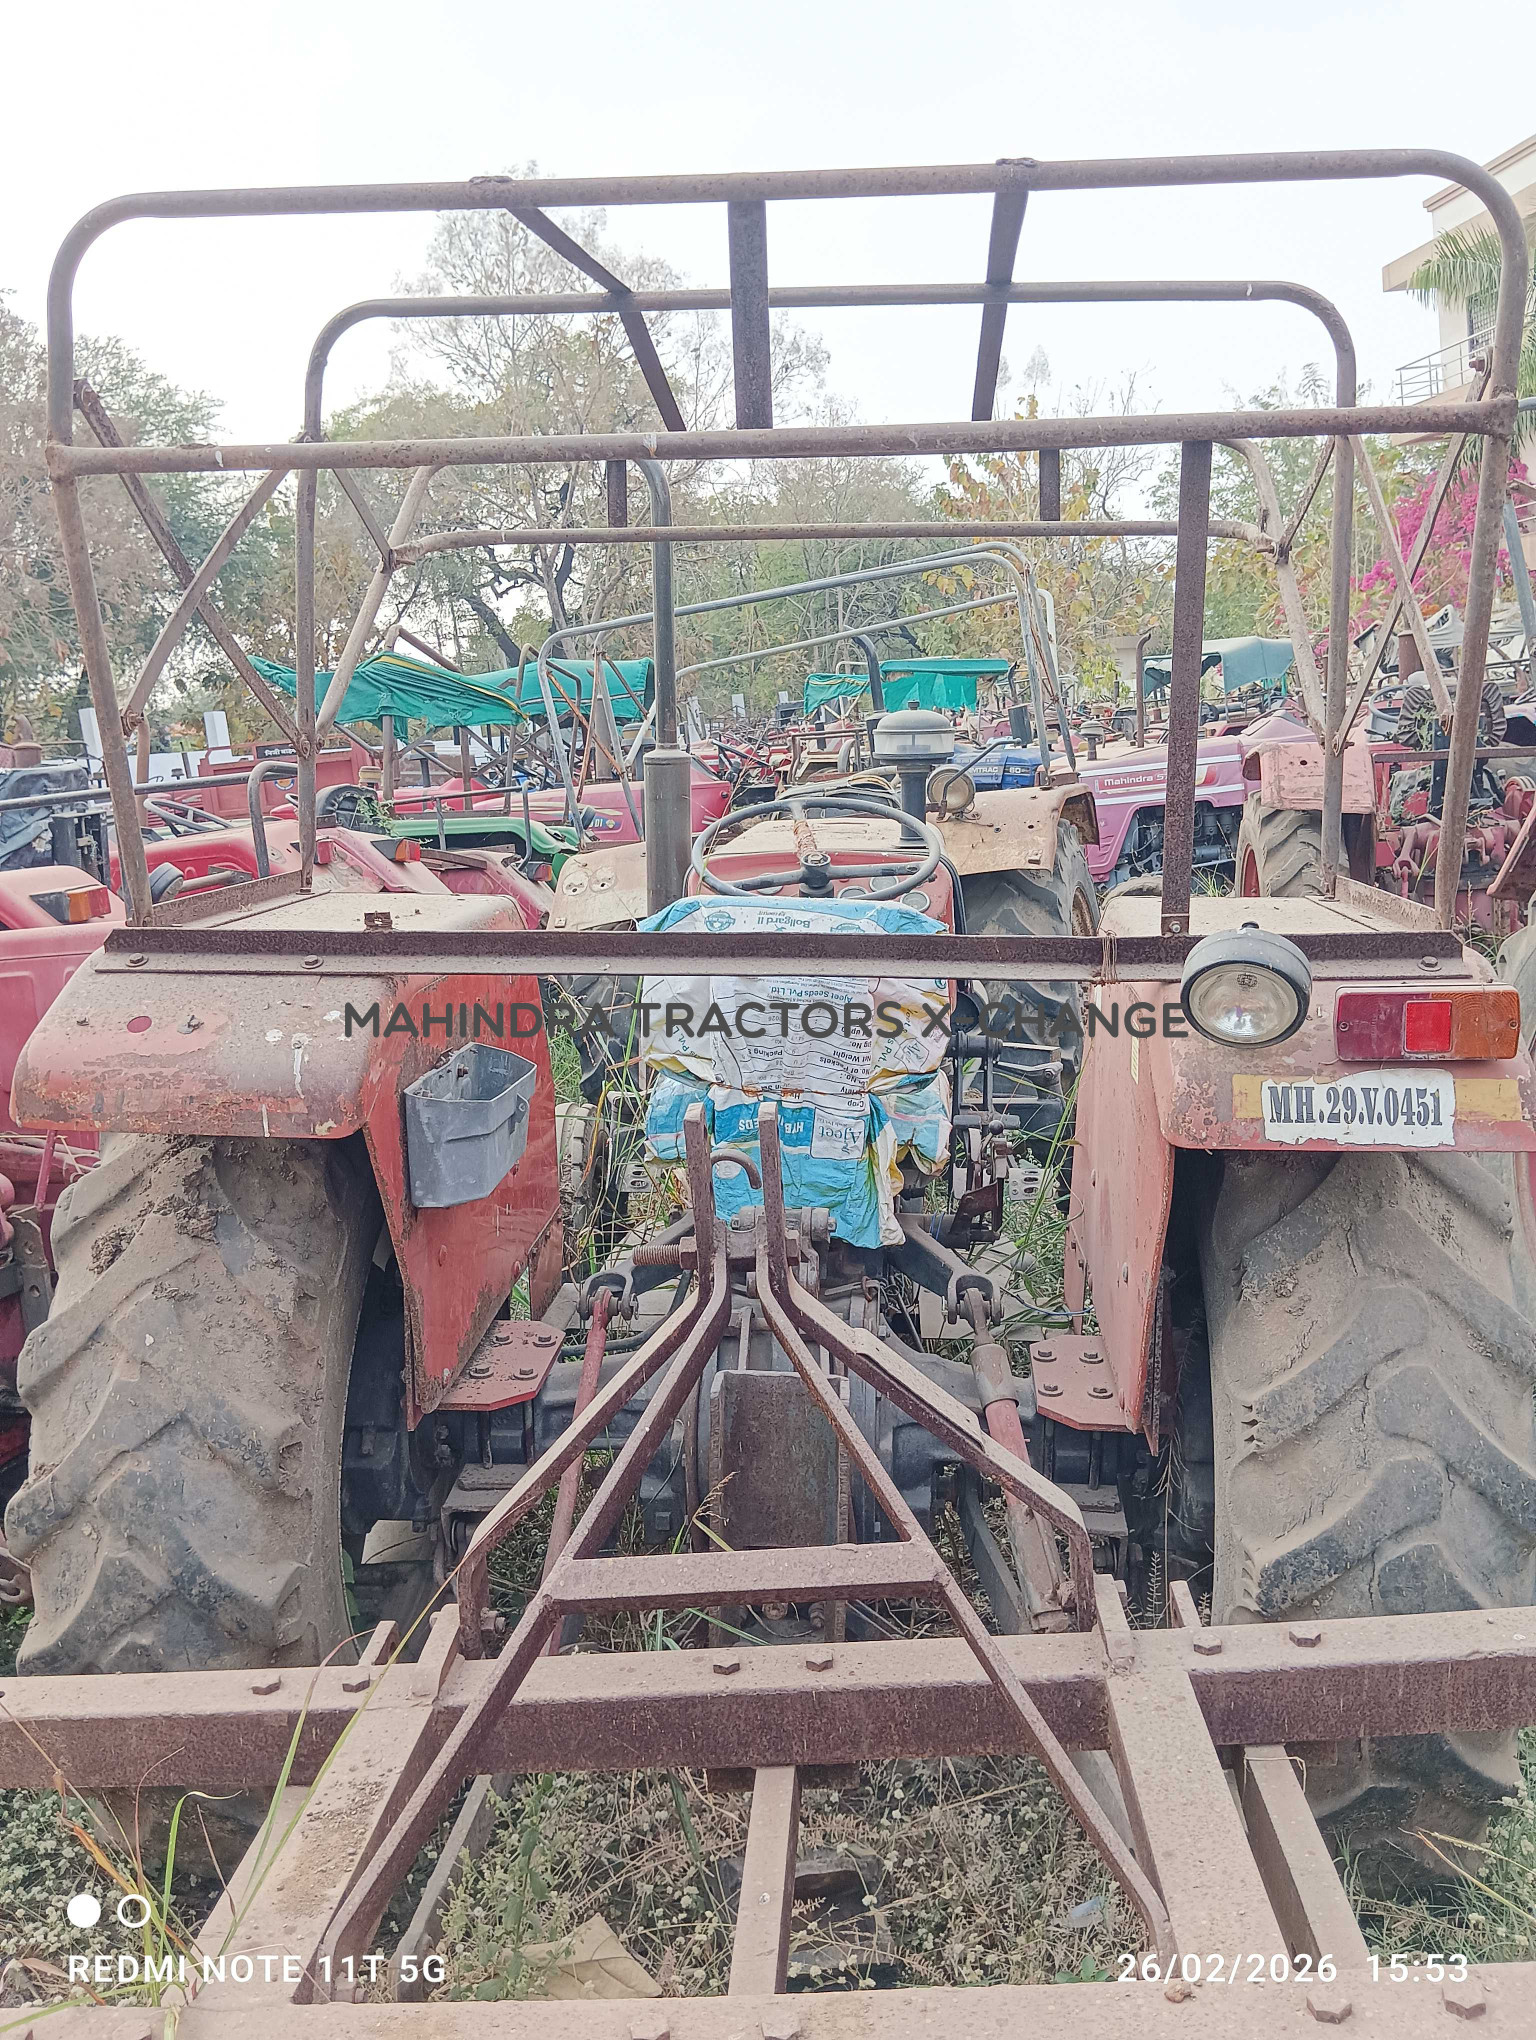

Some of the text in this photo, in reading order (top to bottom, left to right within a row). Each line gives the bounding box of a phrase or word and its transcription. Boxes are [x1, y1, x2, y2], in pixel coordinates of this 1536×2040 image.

[1104, 775, 1153, 787] Mahindra
[757, 916, 811, 928] Bollgard II
[804, 990, 829, 998] Seeds
[831, 993, 853, 1004] Ajeet
[753, 1048, 783, 1058] Packing
[833, 1051, 860, 1063] Weight
[847, 1100, 865, 1108] Crop
[1267, 1086, 1443, 1127] MH.29.V.0451
[818, 1126, 863, 1145] Ajeet
